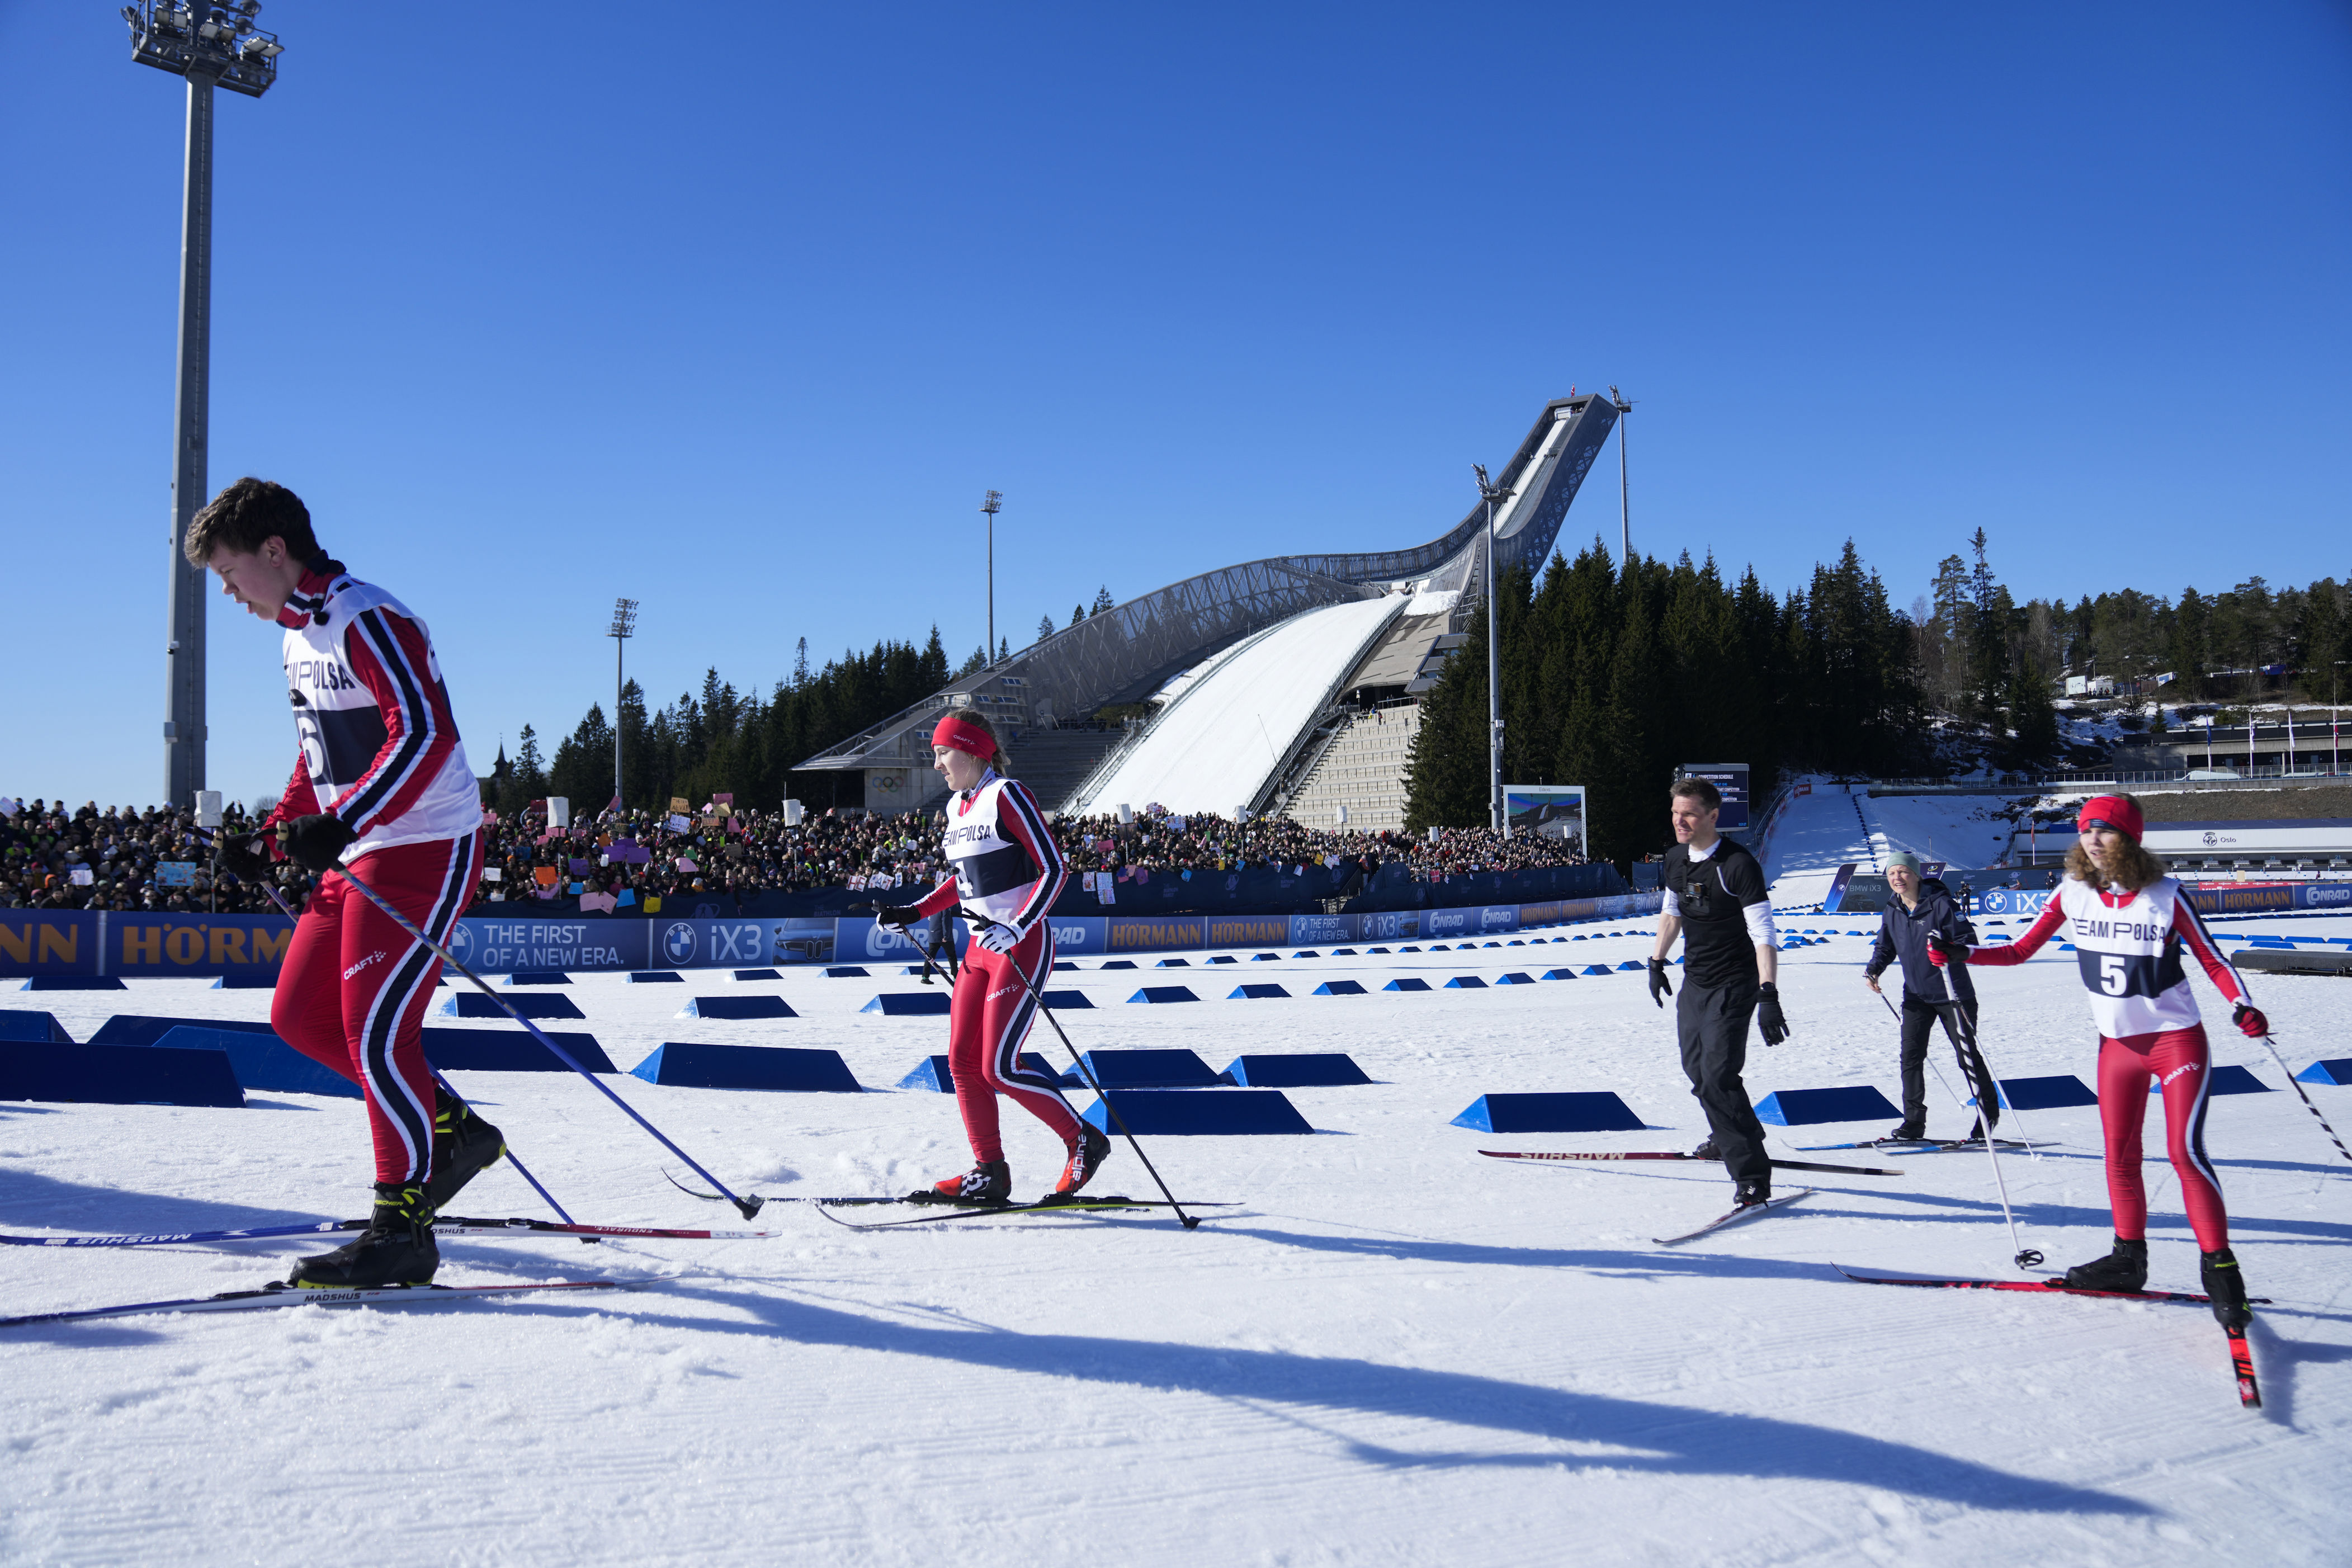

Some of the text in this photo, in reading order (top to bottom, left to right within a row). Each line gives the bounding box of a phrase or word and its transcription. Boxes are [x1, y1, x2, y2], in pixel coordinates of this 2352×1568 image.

[297, 717, 324, 779] 6
[953, 734, 971, 743] CRAFT
[955, 861, 974, 898] 4
[2225, 891, 2290, 909] HÖRMANN
[2306, 886, 2350, 905] CONRAD
[1481, 908, 1512, 928] CONRAD
[1521, 905, 1558, 922] HÖRMANN
[1562, 901, 1594, 918] HÖRMANN
[668, 924, 693, 937] BMW
[1211, 921, 1286, 943] HÖRMANN
[1310, 918, 1340, 929] THE FIRST
[1378, 915, 1395, 937] iX3
[1429, 911, 1463, 933] CONRAD
[484, 925, 526, 944] THE
[532, 925, 587, 944] FIRST
[711, 924, 762, 961] iX3
[866, 923, 959, 957] CONR
[1112, 923, 1201, 947] HÖRMANN
[1309, 929, 1350, 941] OF A NEW ERA.
[2113, 922, 2166, 943] PØLSA
[483, 947, 625, 967] OF A NEW ERA.
[343, 955, 374, 980] CRAFT
[1015, 965, 1031, 988] SWIX
[2100, 955, 2127, 996] 5
[986, 986, 1011, 1002] CRAFT
[2163, 1064, 2191, 1085] CRAFT
[1071, 1134, 1087, 1182] alpina
[1519, 1152, 1626, 1160] MADSHUS
[74, 1233, 192, 1245] MADSHUS
[304, 1292, 361, 1302] MADSHUS
